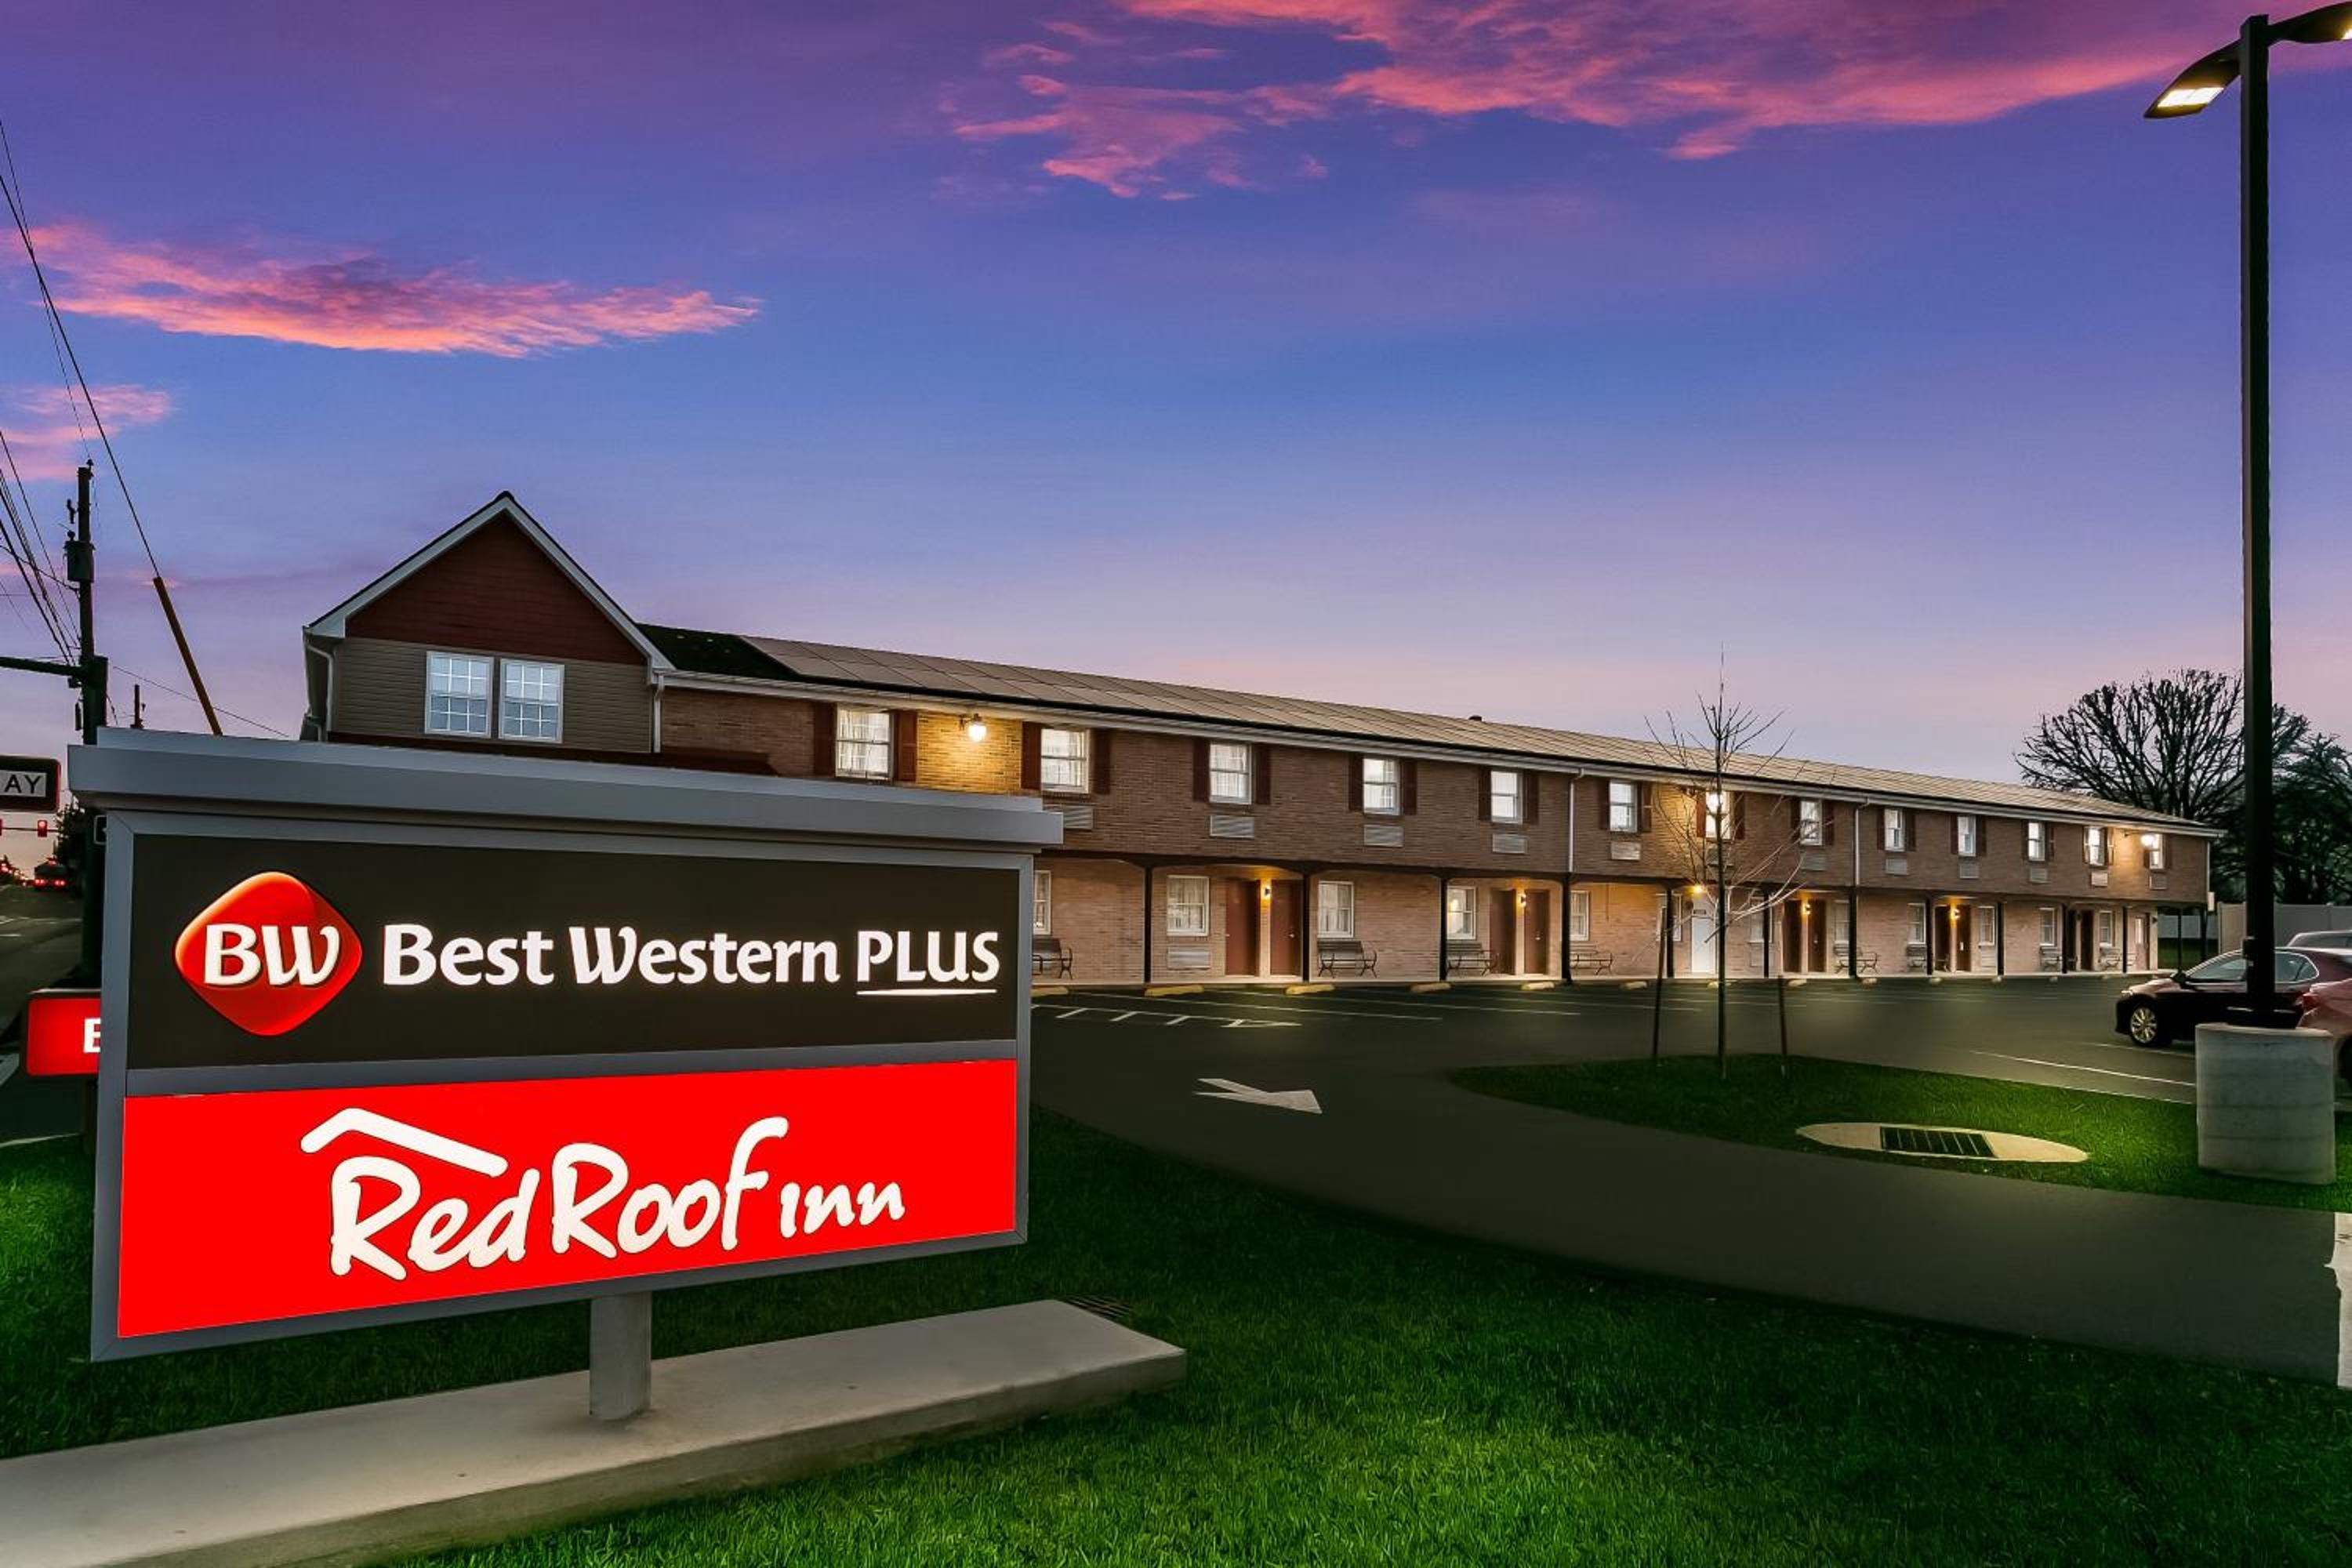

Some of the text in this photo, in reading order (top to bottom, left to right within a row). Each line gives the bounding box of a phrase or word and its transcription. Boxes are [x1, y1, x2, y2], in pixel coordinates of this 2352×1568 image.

[203, 923, 340, 986] BW
[382, 923, 1000, 986] Best Western PLUS
